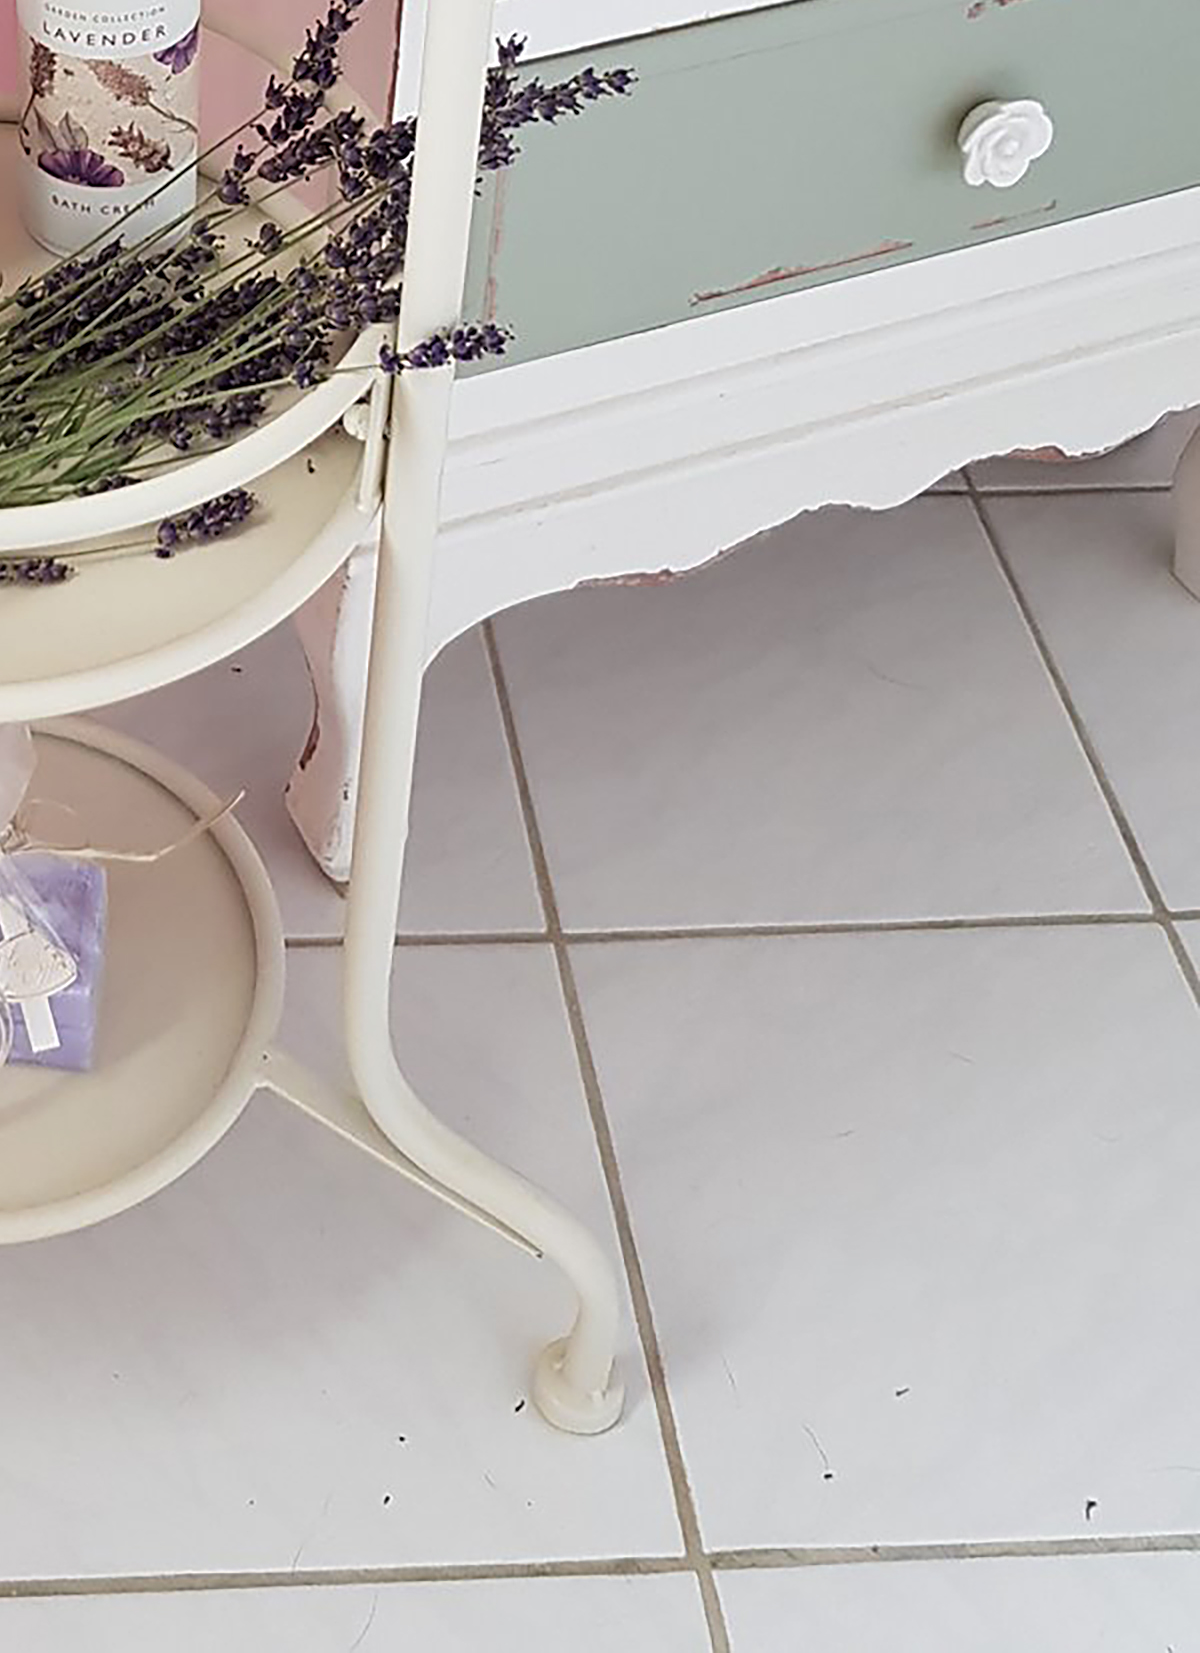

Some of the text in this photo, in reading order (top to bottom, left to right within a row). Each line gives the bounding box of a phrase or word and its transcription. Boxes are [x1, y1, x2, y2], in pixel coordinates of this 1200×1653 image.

[44, 3, 165, 23] GARDEN COLLECTION
[43, 20, 166, 46] LAVENDER
[52, 195, 155, 216] BATH CREM
